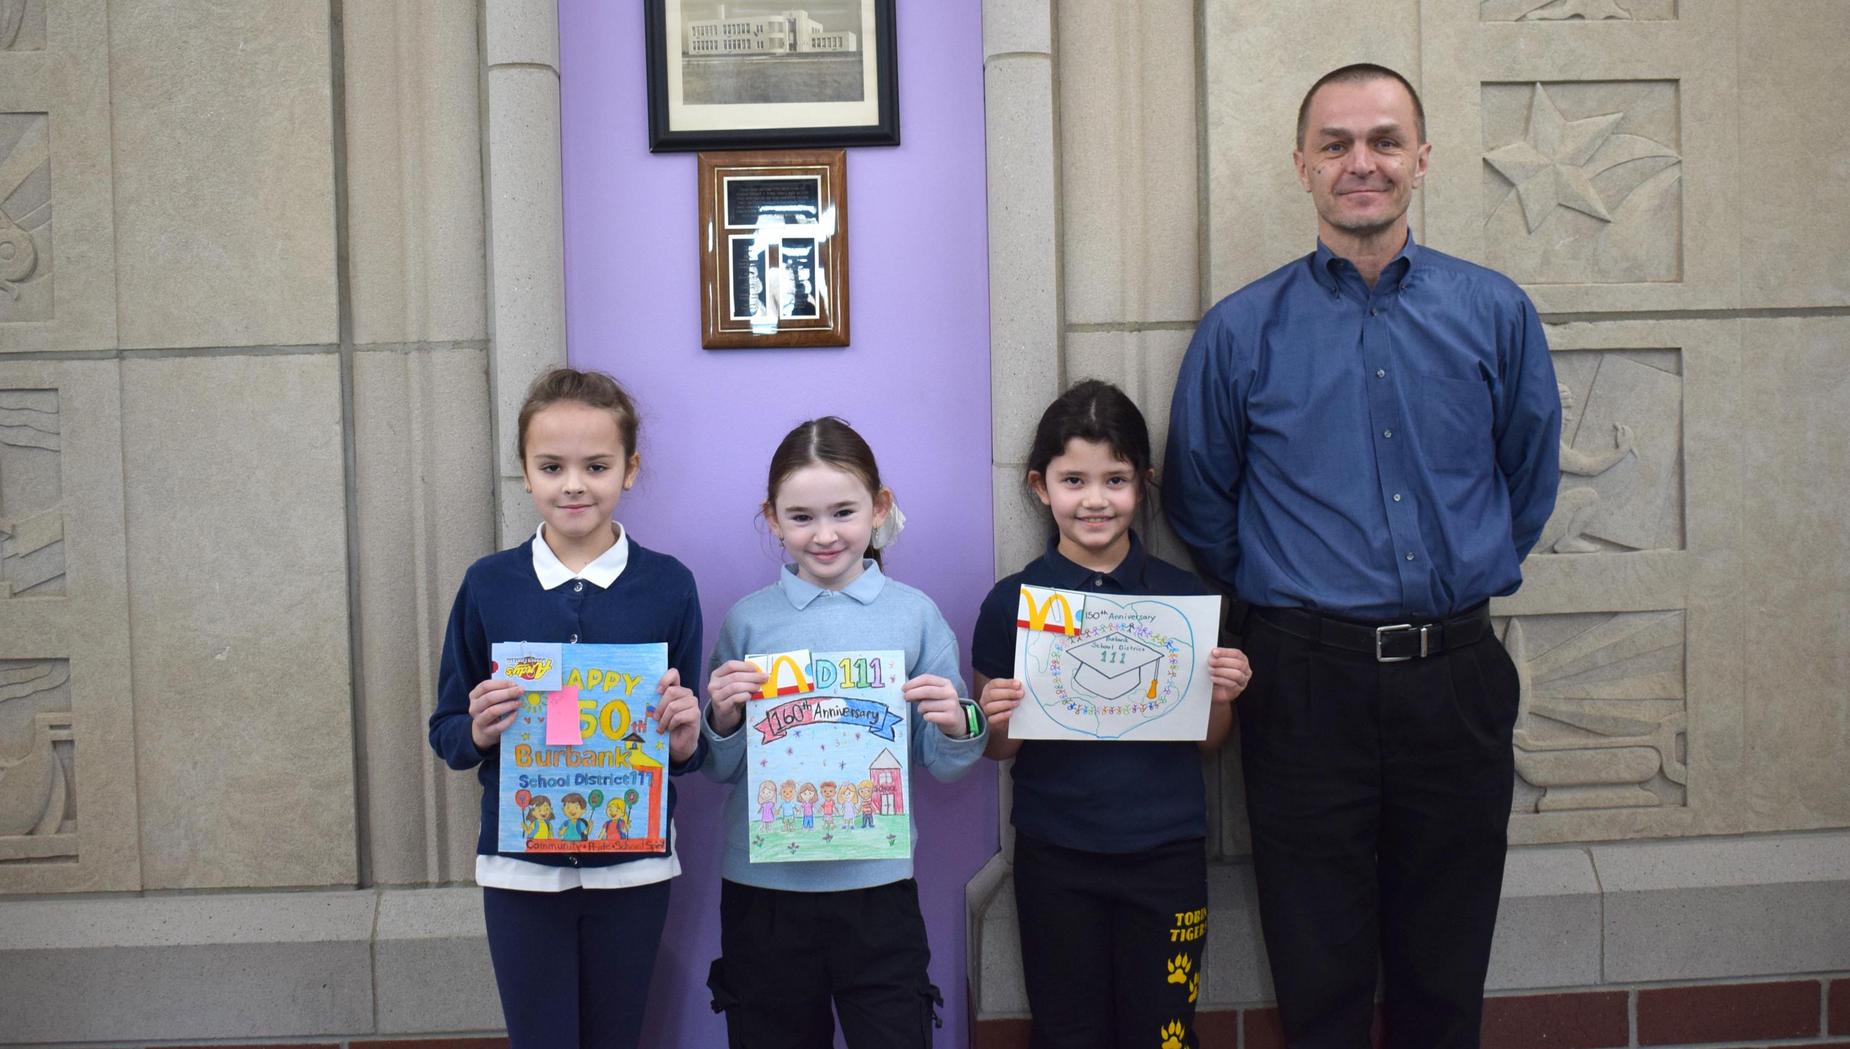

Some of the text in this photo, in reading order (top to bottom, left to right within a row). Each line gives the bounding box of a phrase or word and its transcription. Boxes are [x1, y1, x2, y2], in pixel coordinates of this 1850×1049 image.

[1108, 612, 1156, 622] Anniversary
[1091, 641, 1113, 650] School
[1100, 650, 1125, 664] 111
[815, 657, 885, 689] D111
[771, 699, 879, 730] 160th Anniversary
[514, 743, 631, 768] Burbank
[519, 774, 570, 788] School
